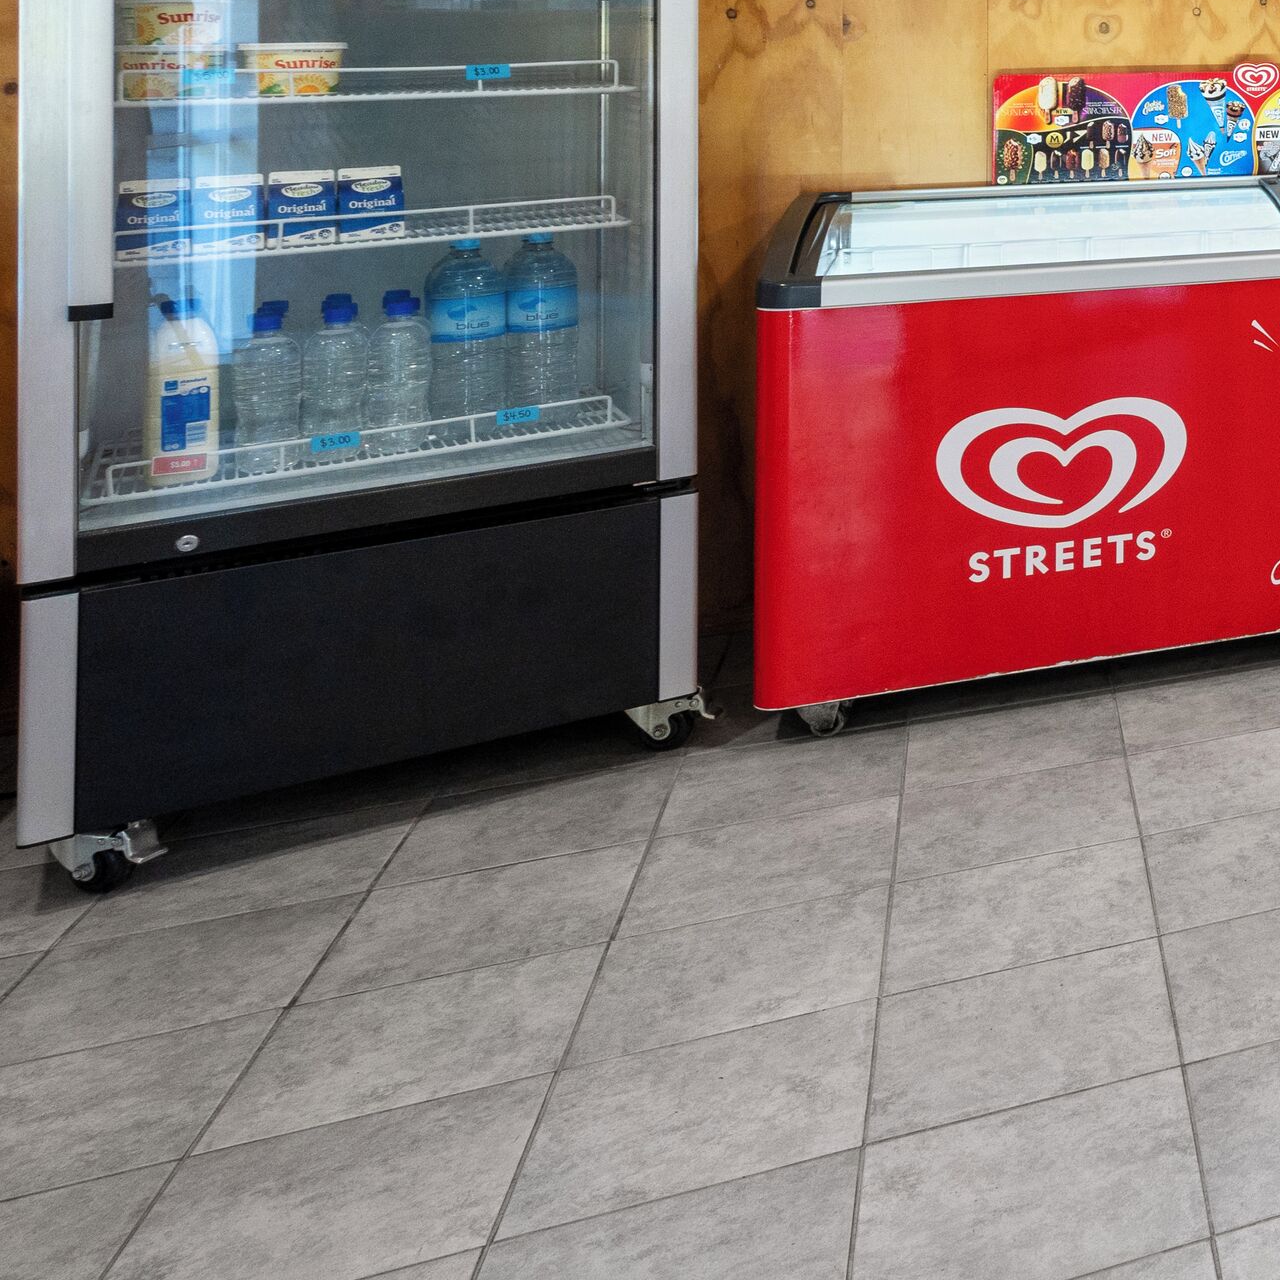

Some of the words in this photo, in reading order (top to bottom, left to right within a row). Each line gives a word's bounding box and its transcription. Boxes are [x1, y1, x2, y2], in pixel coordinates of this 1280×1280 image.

[156, 10, 221, 25] Sunrise
[474, 66, 500, 76] $3.00
[1152, 133, 1173, 142] NEW
[1259, 130, 1280, 139] NEW
[1155, 149, 1176, 159] Soft
[278, 198, 327, 215] Original
[349, 194, 396, 211] Original
[127, 209, 181, 226] Original
[204, 203, 256, 221] Original
[526, 311, 560, 322] blue
[455, 320, 491, 331] blue
[503, 409, 531, 422] $4.50
[320, 434, 352, 449] $3.00
